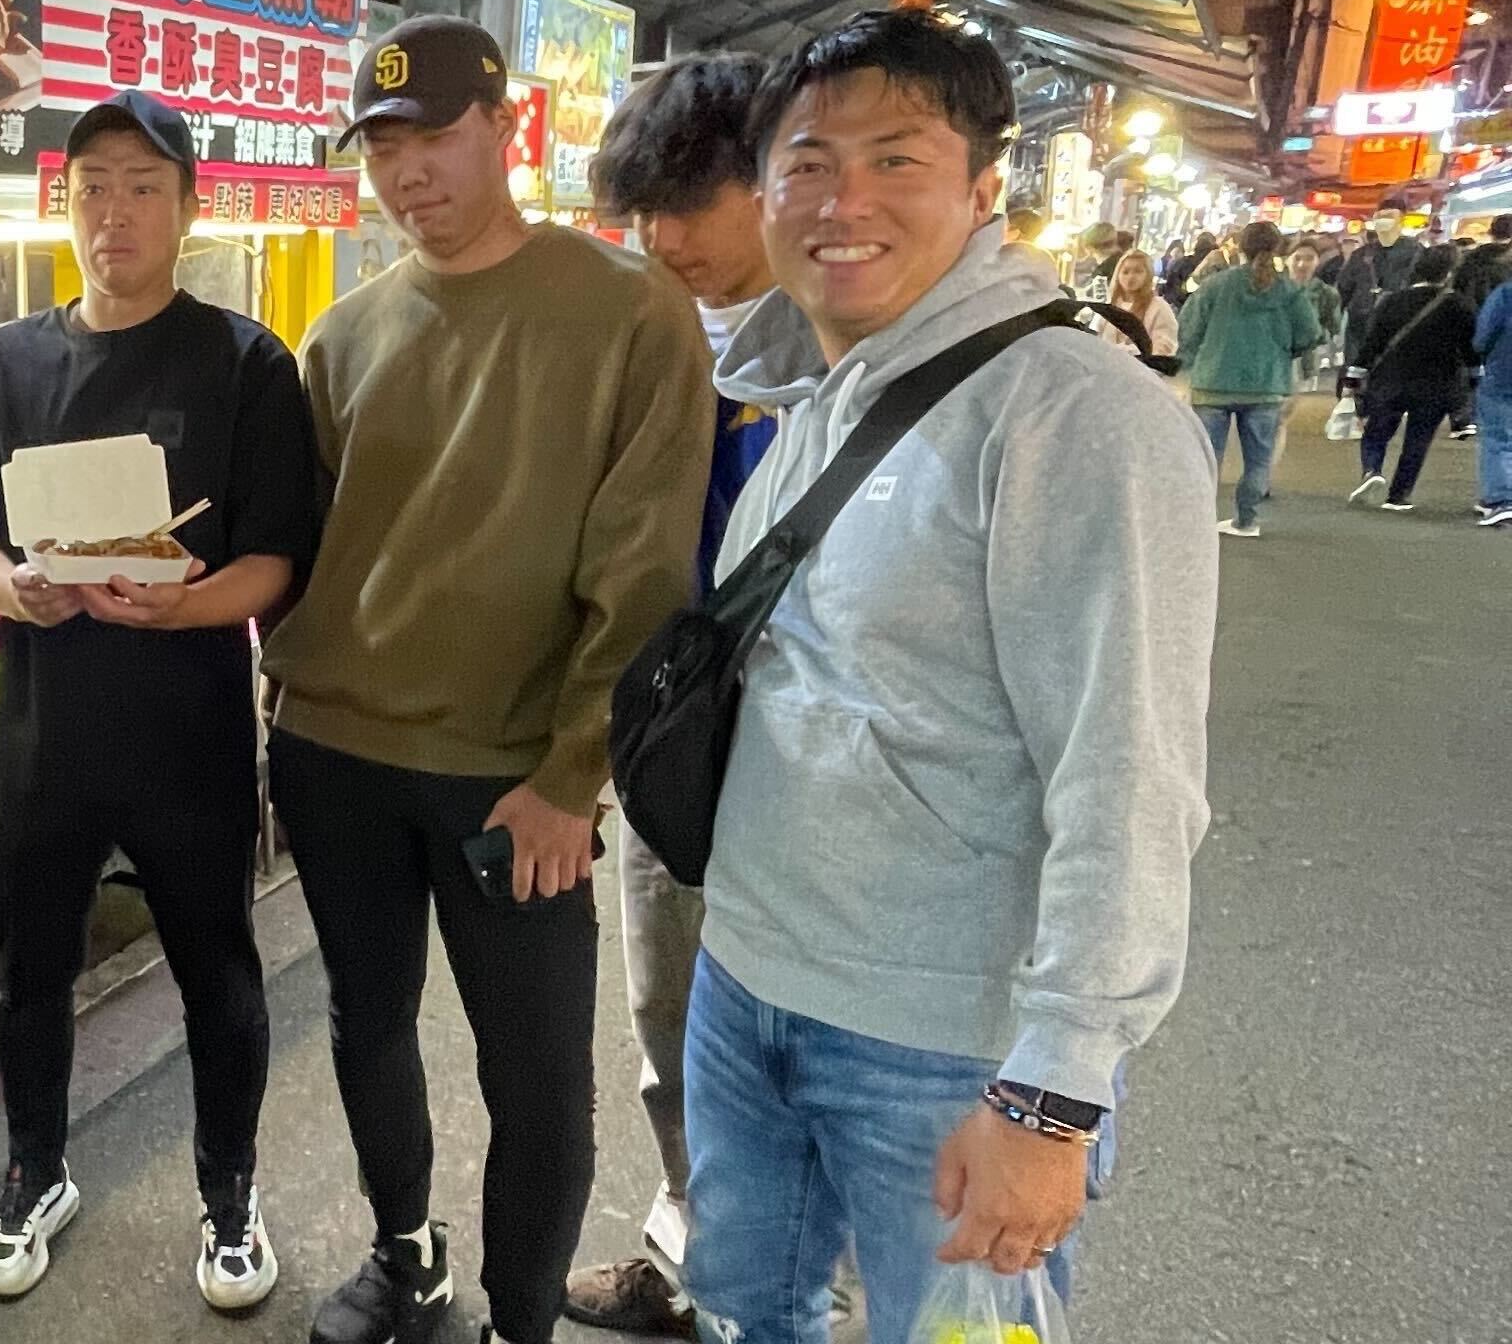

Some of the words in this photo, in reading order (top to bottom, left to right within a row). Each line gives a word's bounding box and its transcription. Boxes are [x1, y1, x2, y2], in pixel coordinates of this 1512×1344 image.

[107, 8, 326, 112] 香酥臭豆腐
[180, 111, 216, 162] 汁
[234, 117, 315, 167] 招牌素食
